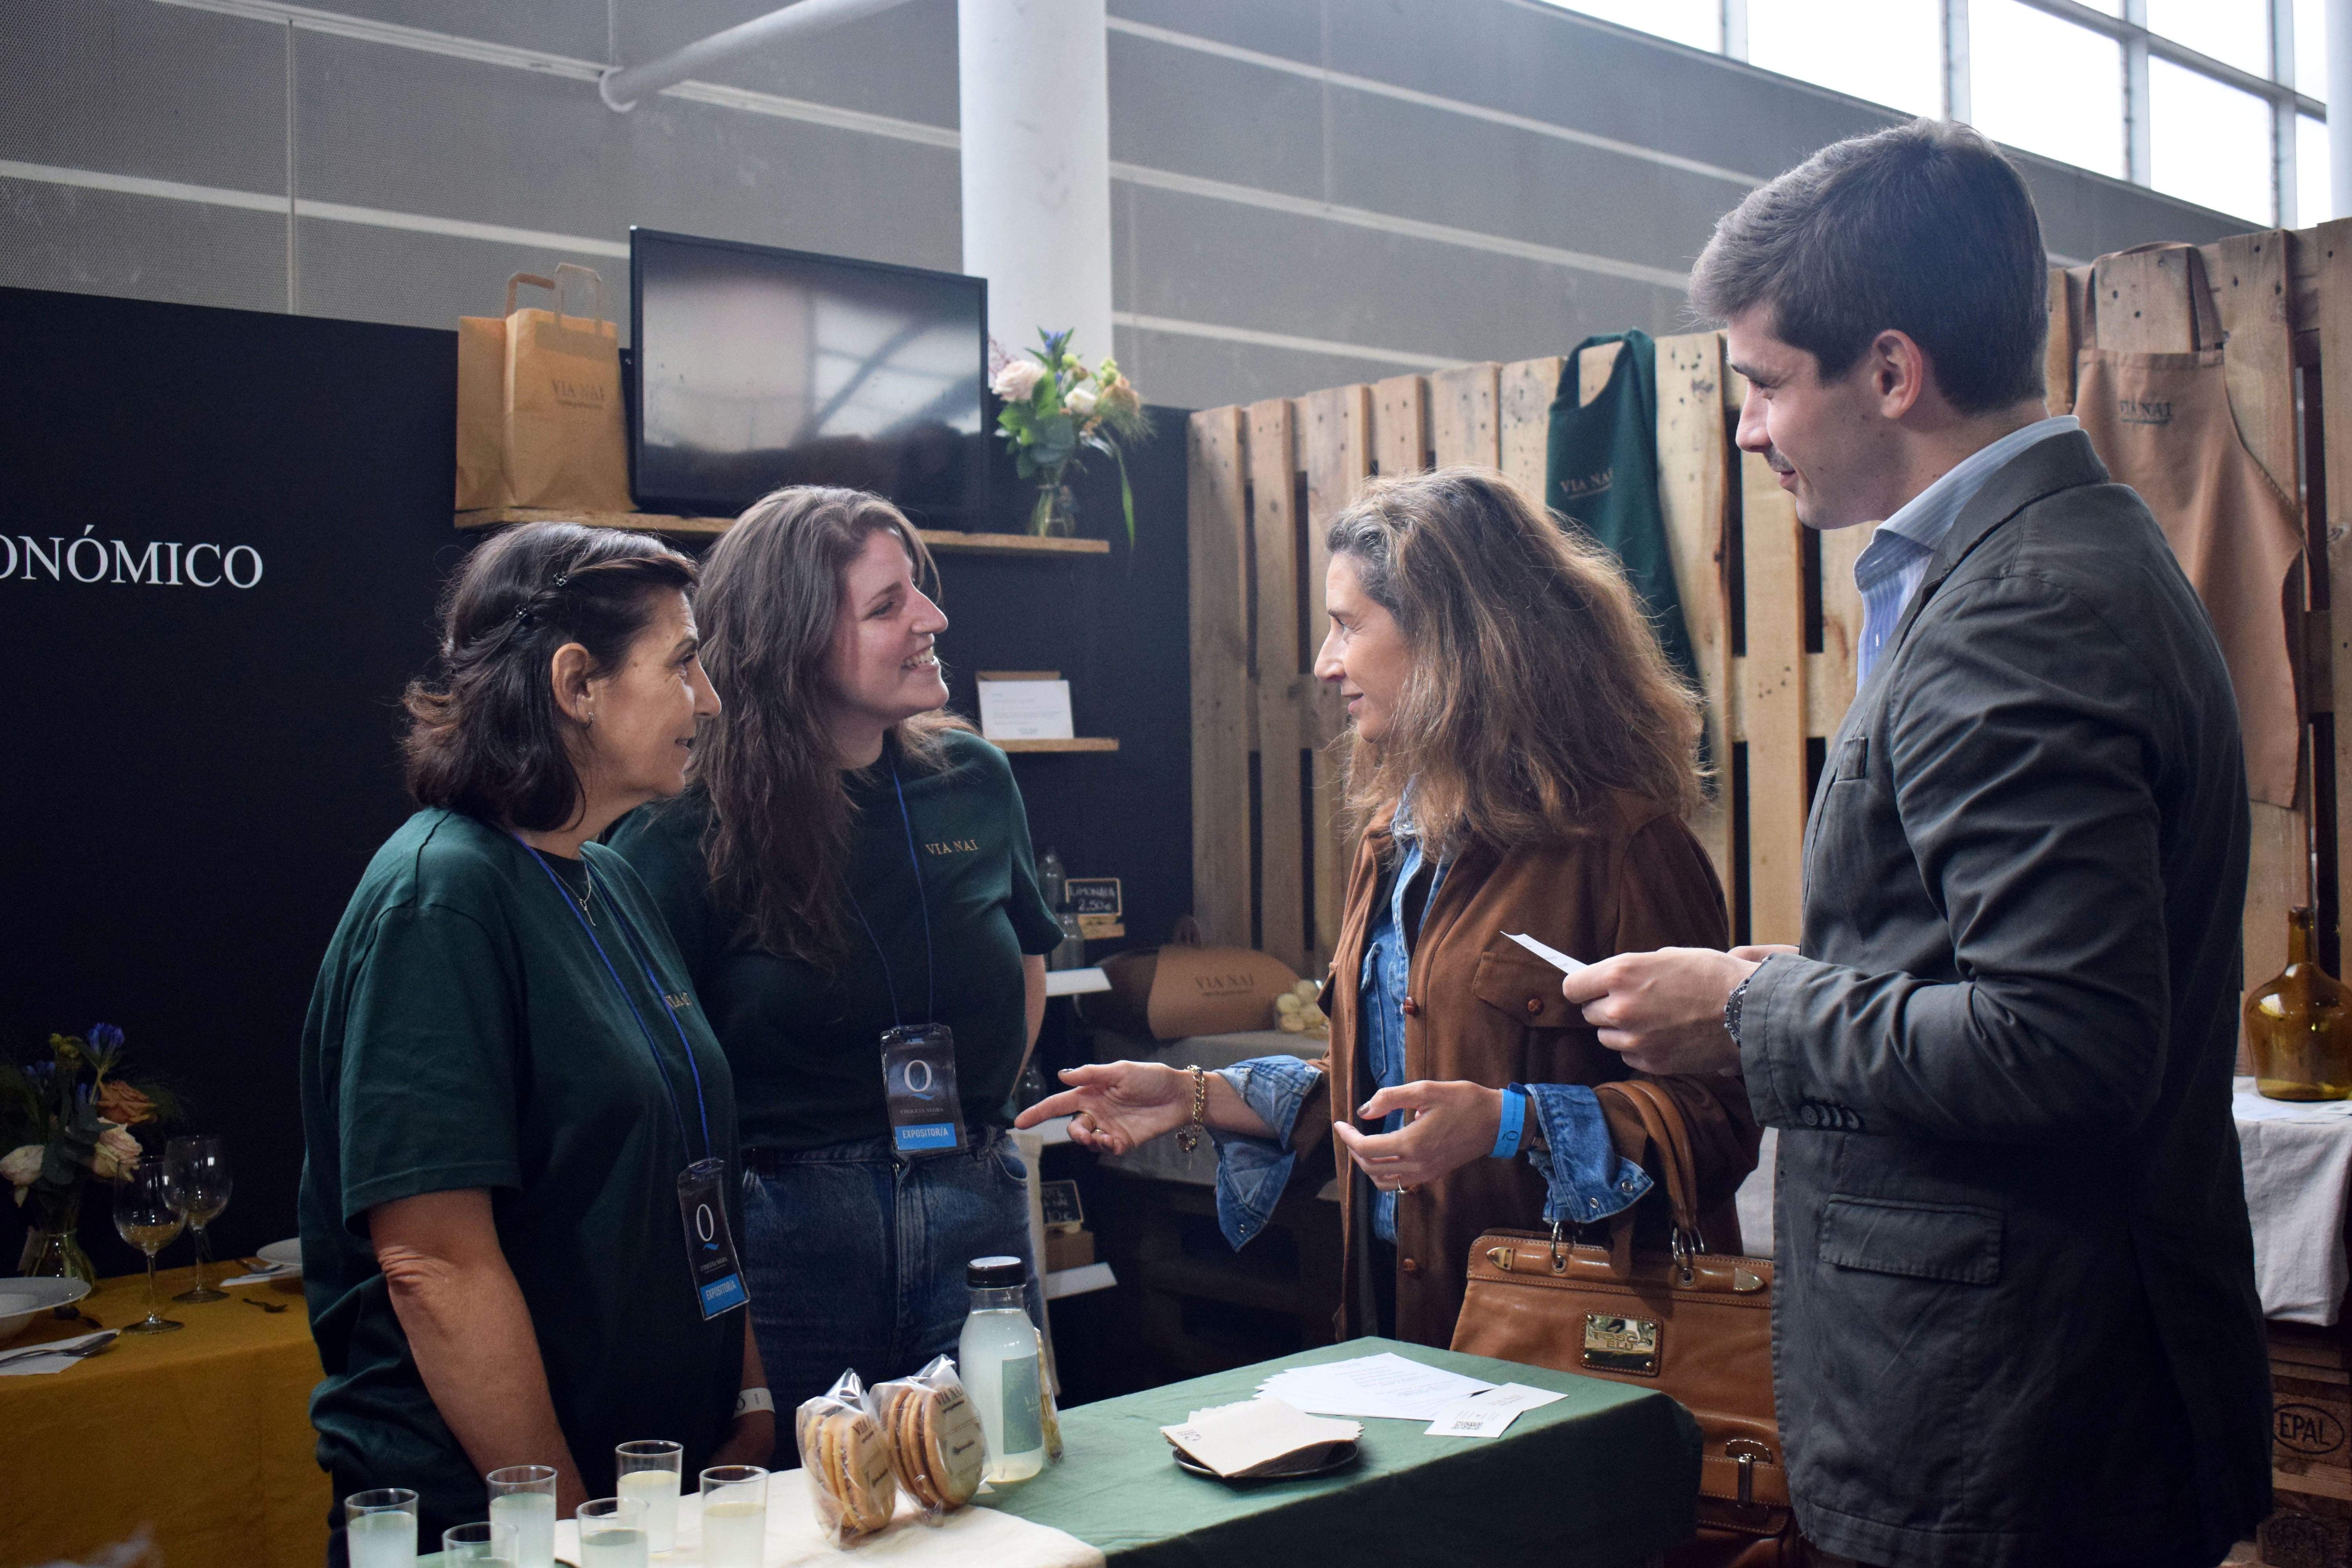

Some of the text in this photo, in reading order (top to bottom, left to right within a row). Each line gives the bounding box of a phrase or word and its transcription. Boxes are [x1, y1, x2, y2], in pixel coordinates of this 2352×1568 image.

[2120, 400, 2173, 417] VIA NAI
[1560, 479, 1587, 492] VIA
[925, 839, 980, 855] VIA NAI
[1195, 973, 1254, 990] VIA NAI
[902, 1127, 949, 1139] EXPOSITOR/A
[706, 1279, 737, 1300] EXPOSITOR/A
[1593, 1330, 1653, 1346] TOSCA
[1606, 1341, 1633, 1350] BLU
[933, 1391, 951, 1406] VIA
[2279, 1412, 2330, 1446] EPAL
